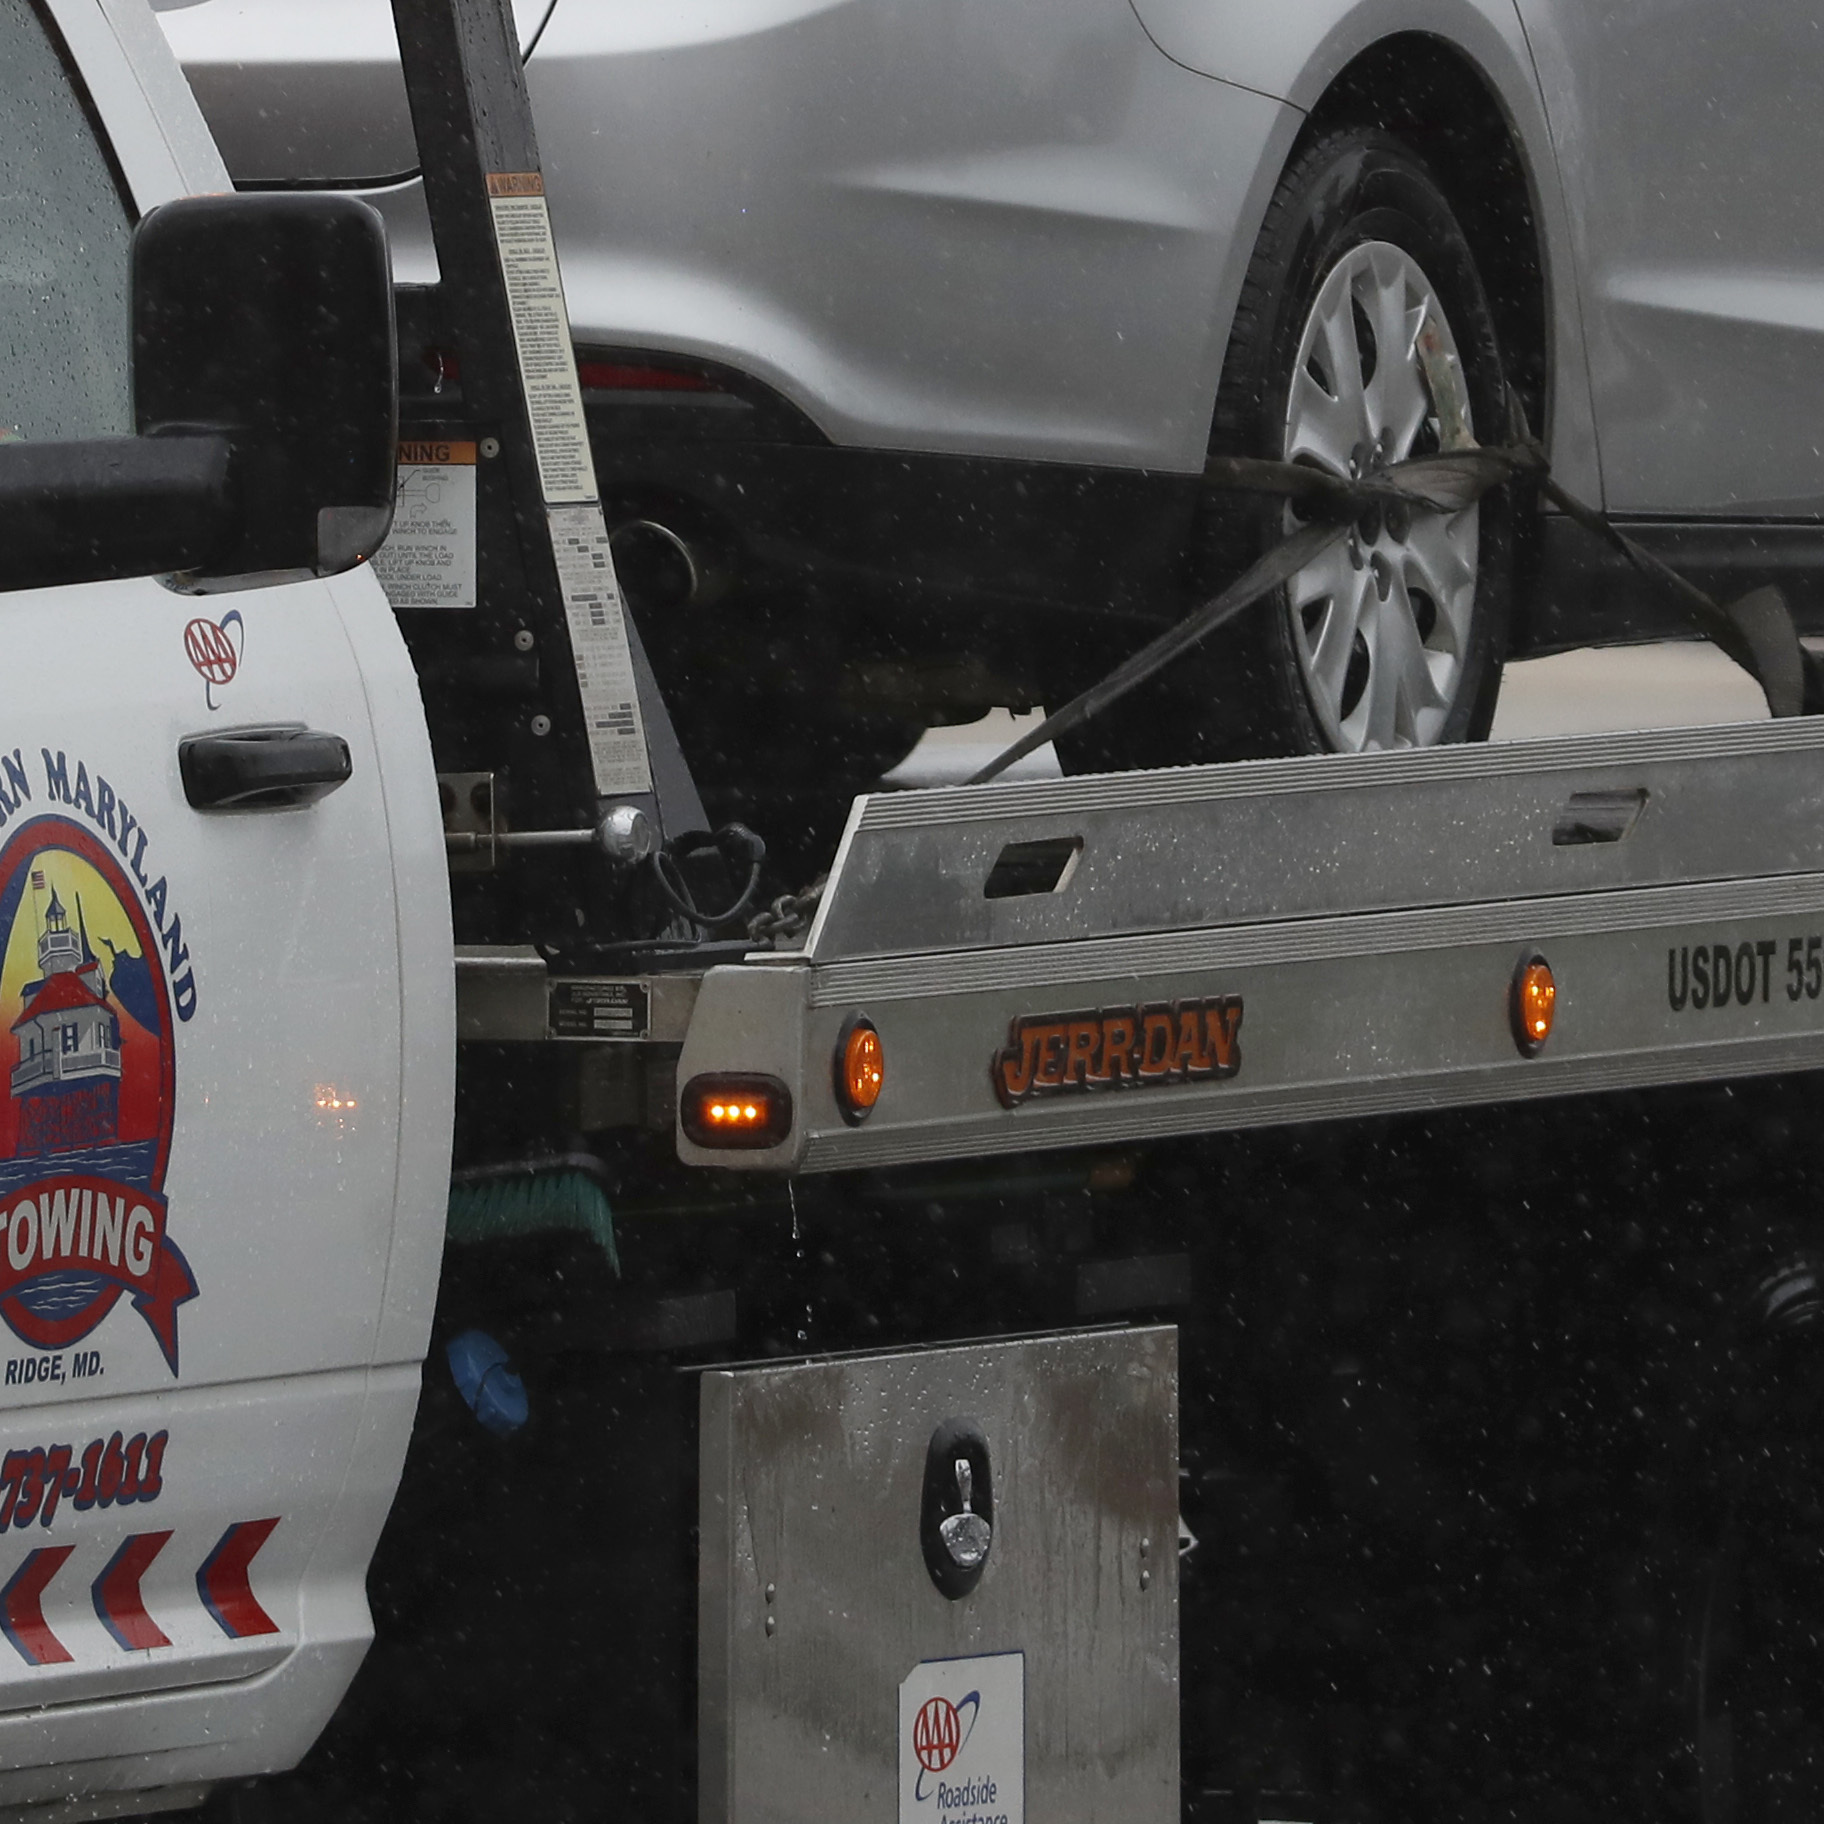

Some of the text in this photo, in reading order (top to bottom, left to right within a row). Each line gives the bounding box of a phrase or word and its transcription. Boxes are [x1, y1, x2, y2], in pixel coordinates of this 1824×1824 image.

[491, 176, 542, 194] WARNING
[399, 444, 451, 463] NING
[43, 747, 197, 1024] MARYLAND
[1667, 940, 1777, 1012] USDOT
[5, 1351, 105, 1385] RIDGE, MD.
[937, 1775, 997, 1809] Roadside
